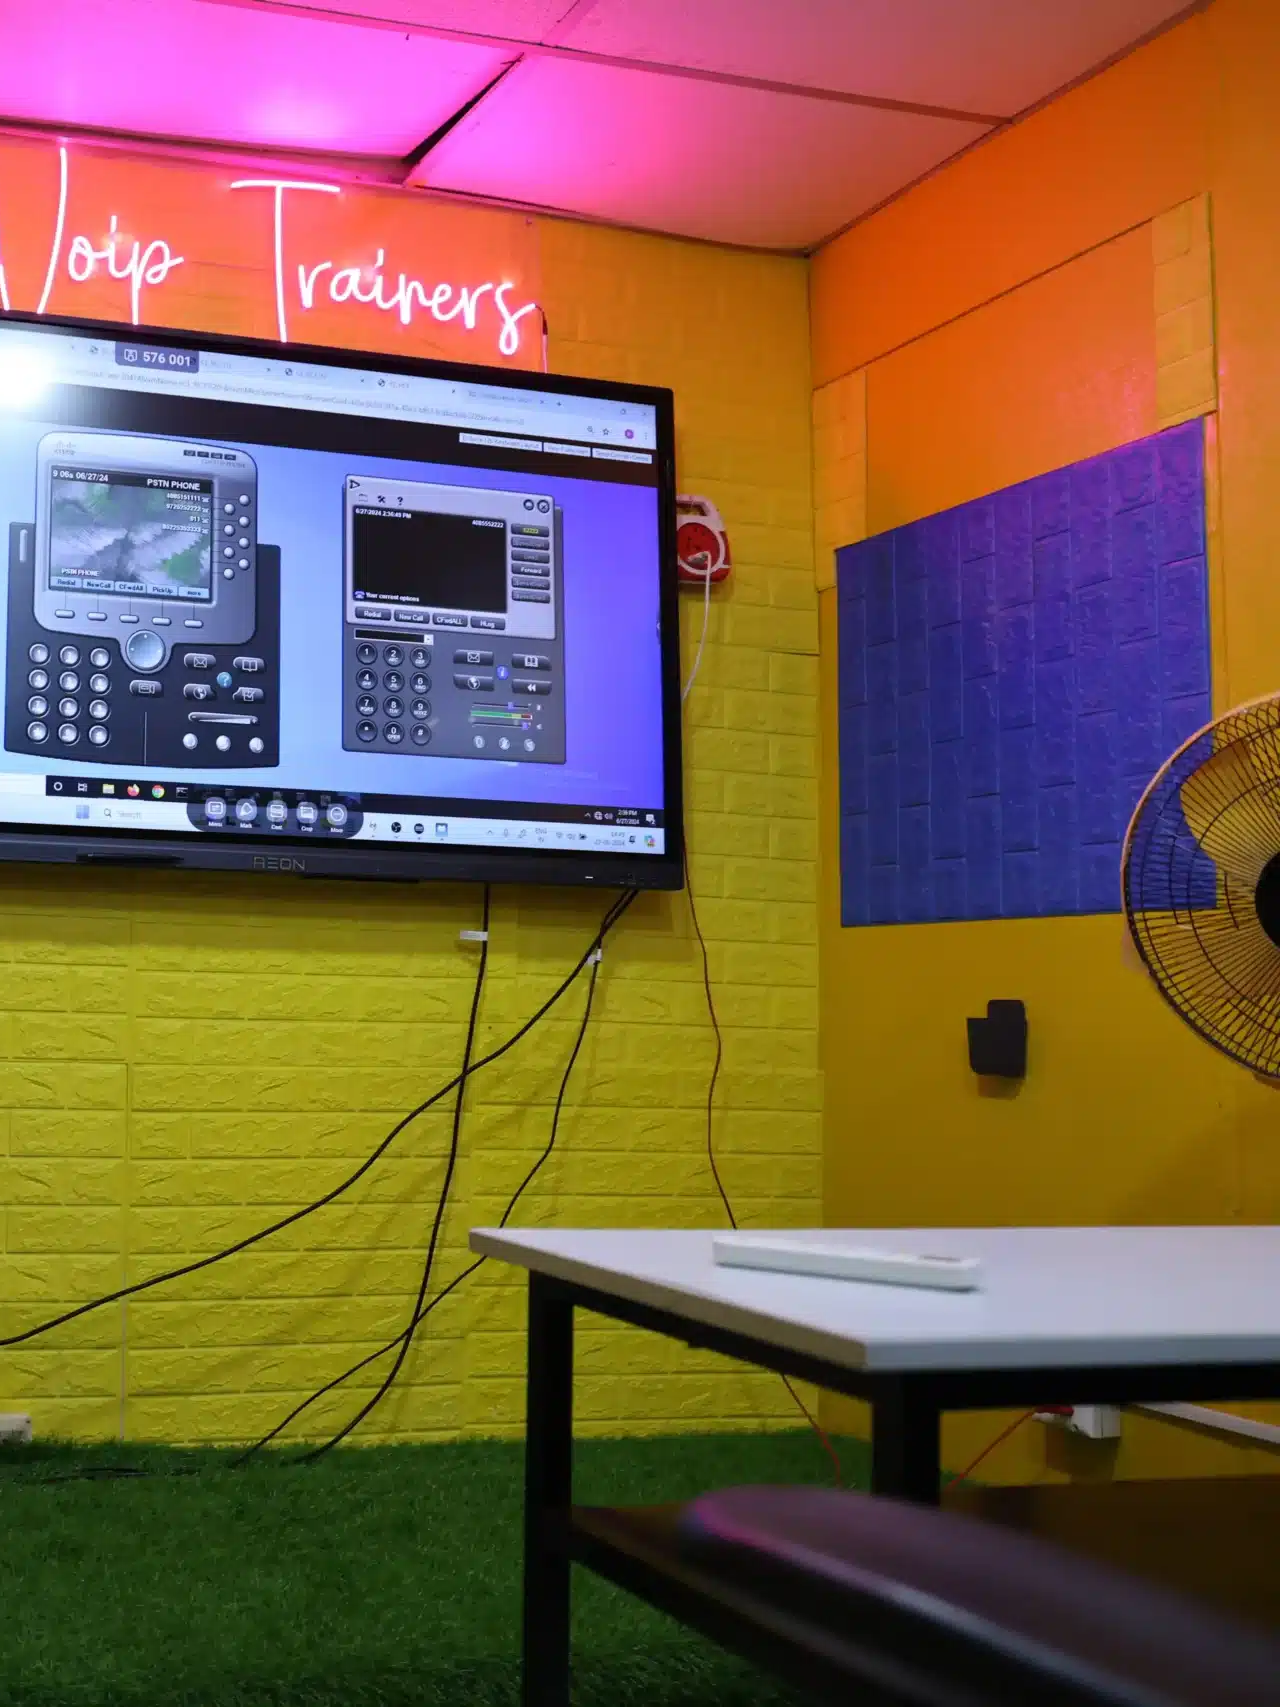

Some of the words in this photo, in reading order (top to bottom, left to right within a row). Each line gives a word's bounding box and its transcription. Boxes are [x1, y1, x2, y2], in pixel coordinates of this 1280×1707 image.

[229, 178, 538, 357] Trainers
[143, 351, 166, 364] 576
[169, 354, 191, 367] 001
[75, 471, 109, 483] 06/27/24
[147, 478, 170, 488] PSTN
[171, 480, 201, 491] PHONE
[366, 591, 378, 599] Your
[378, 593, 399, 601] current
[399, 595, 420, 603] options
[363, 610, 382, 618] Redial
[412, 614, 424, 622] Call
